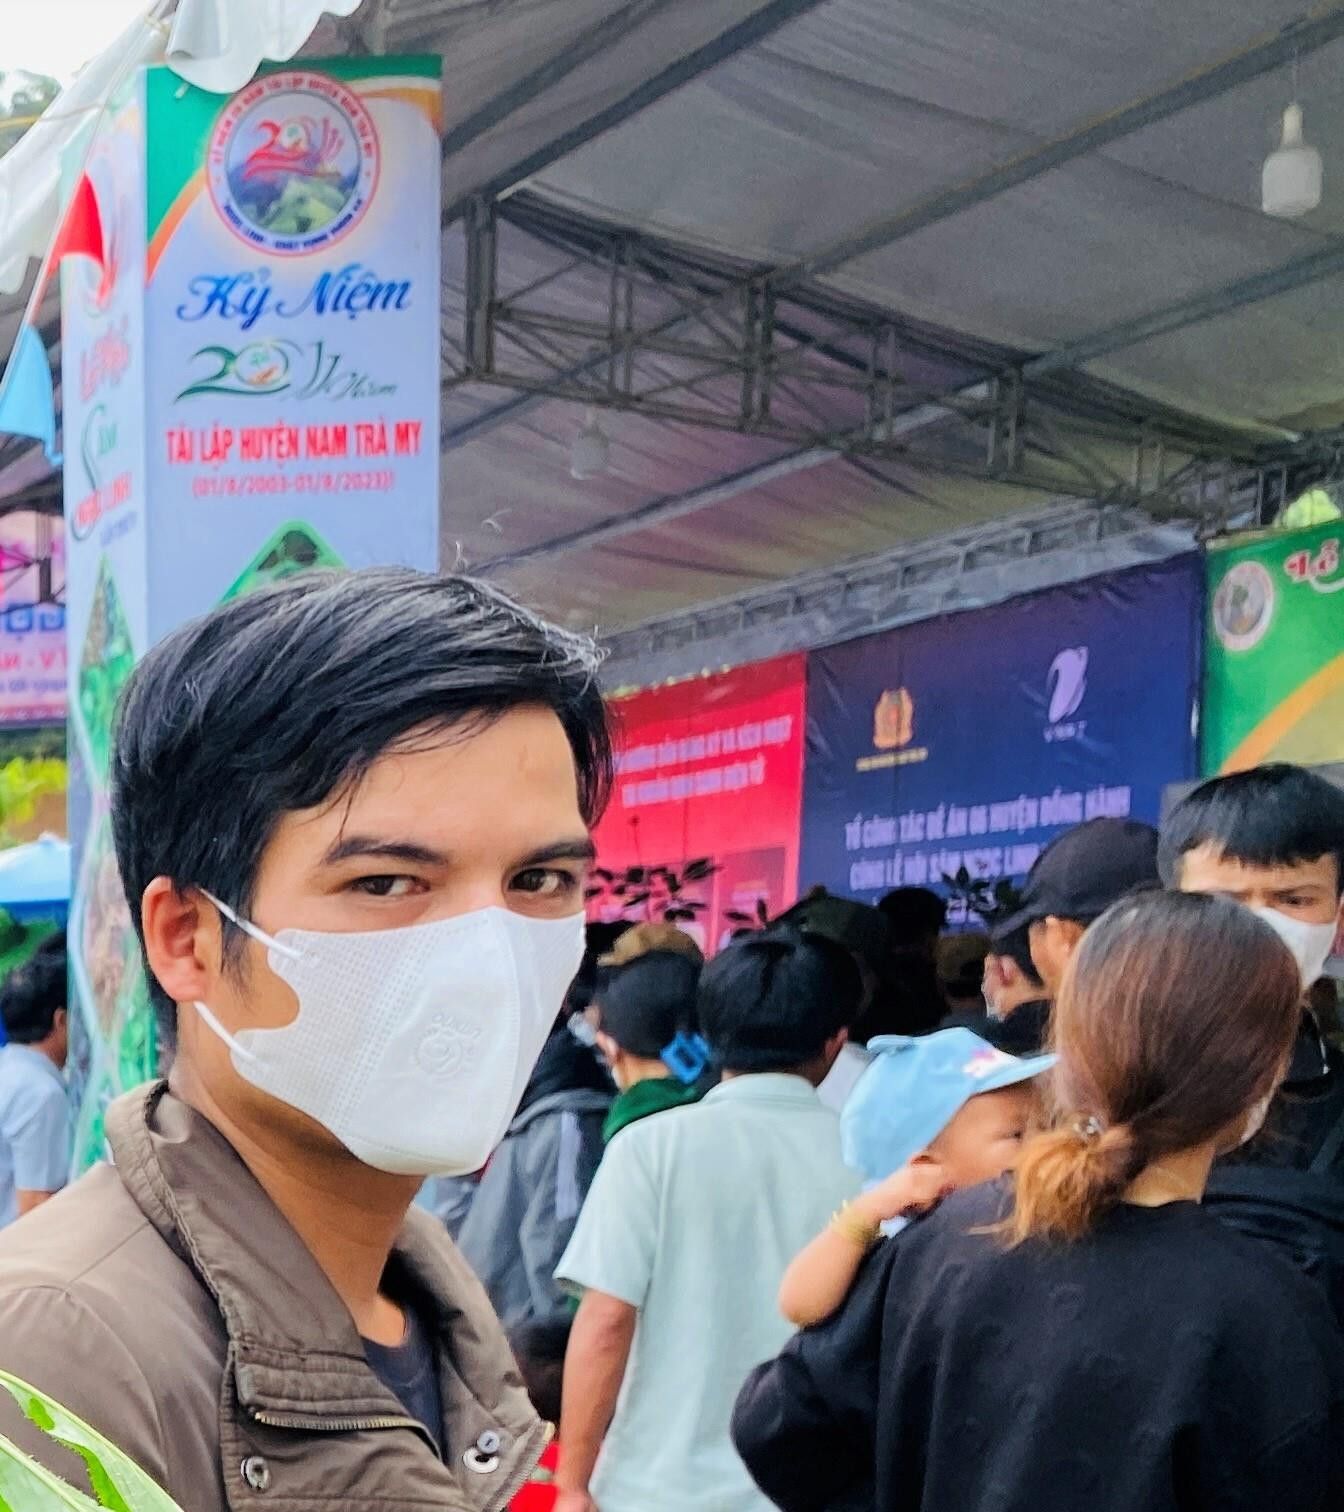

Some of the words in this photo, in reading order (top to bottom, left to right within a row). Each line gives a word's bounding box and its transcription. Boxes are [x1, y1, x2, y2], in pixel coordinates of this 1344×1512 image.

[176, 267, 271, 331] Kỷ
[275, 263, 412, 320] Niệm
[239, 419, 299, 469] HUYỆN
[305, 424, 348, 461] NAM
[354, 415, 388, 457] TRÀ
[394, 420, 422, 456] MY
